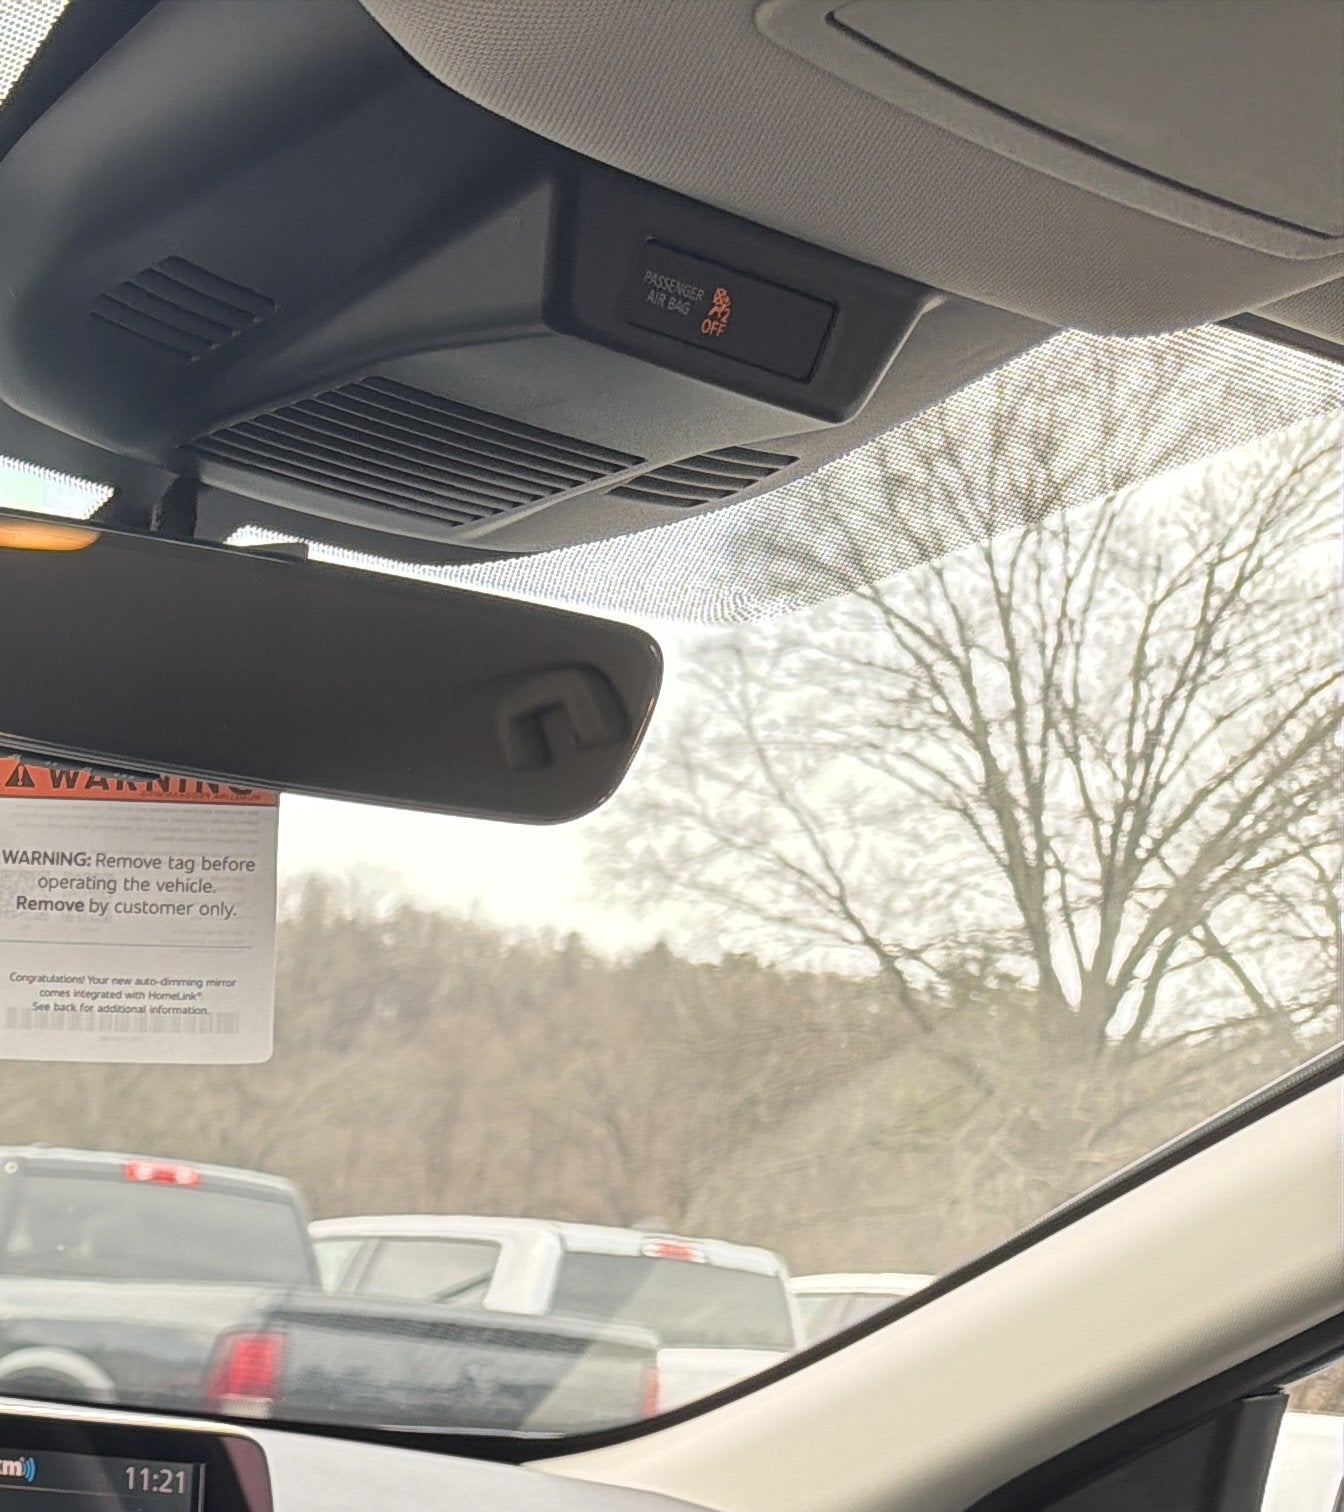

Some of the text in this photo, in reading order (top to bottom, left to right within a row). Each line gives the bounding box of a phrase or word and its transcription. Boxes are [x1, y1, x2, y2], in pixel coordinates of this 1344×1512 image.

[644, 270, 705, 301] PASSENGER
[647, 288, 691, 316] AIR BAG
[701, 319, 727, 336] OFF
[1, 849, 256, 874] WARNING: Remove tag before
[37, 874, 217, 894] operating the vehicle.
[15, 895, 237, 919] Remove by customer only.
[8, 971, 237, 989] Congratulations! Your new auto-dimming mirror
[38, 989, 70, 999] comes
[72, 989, 123, 1001] integrated
[124, 990, 146, 1000] with
[31, 1001, 211, 1015] See back for additional information.
[125, 1466, 188, 1494] 11:21
